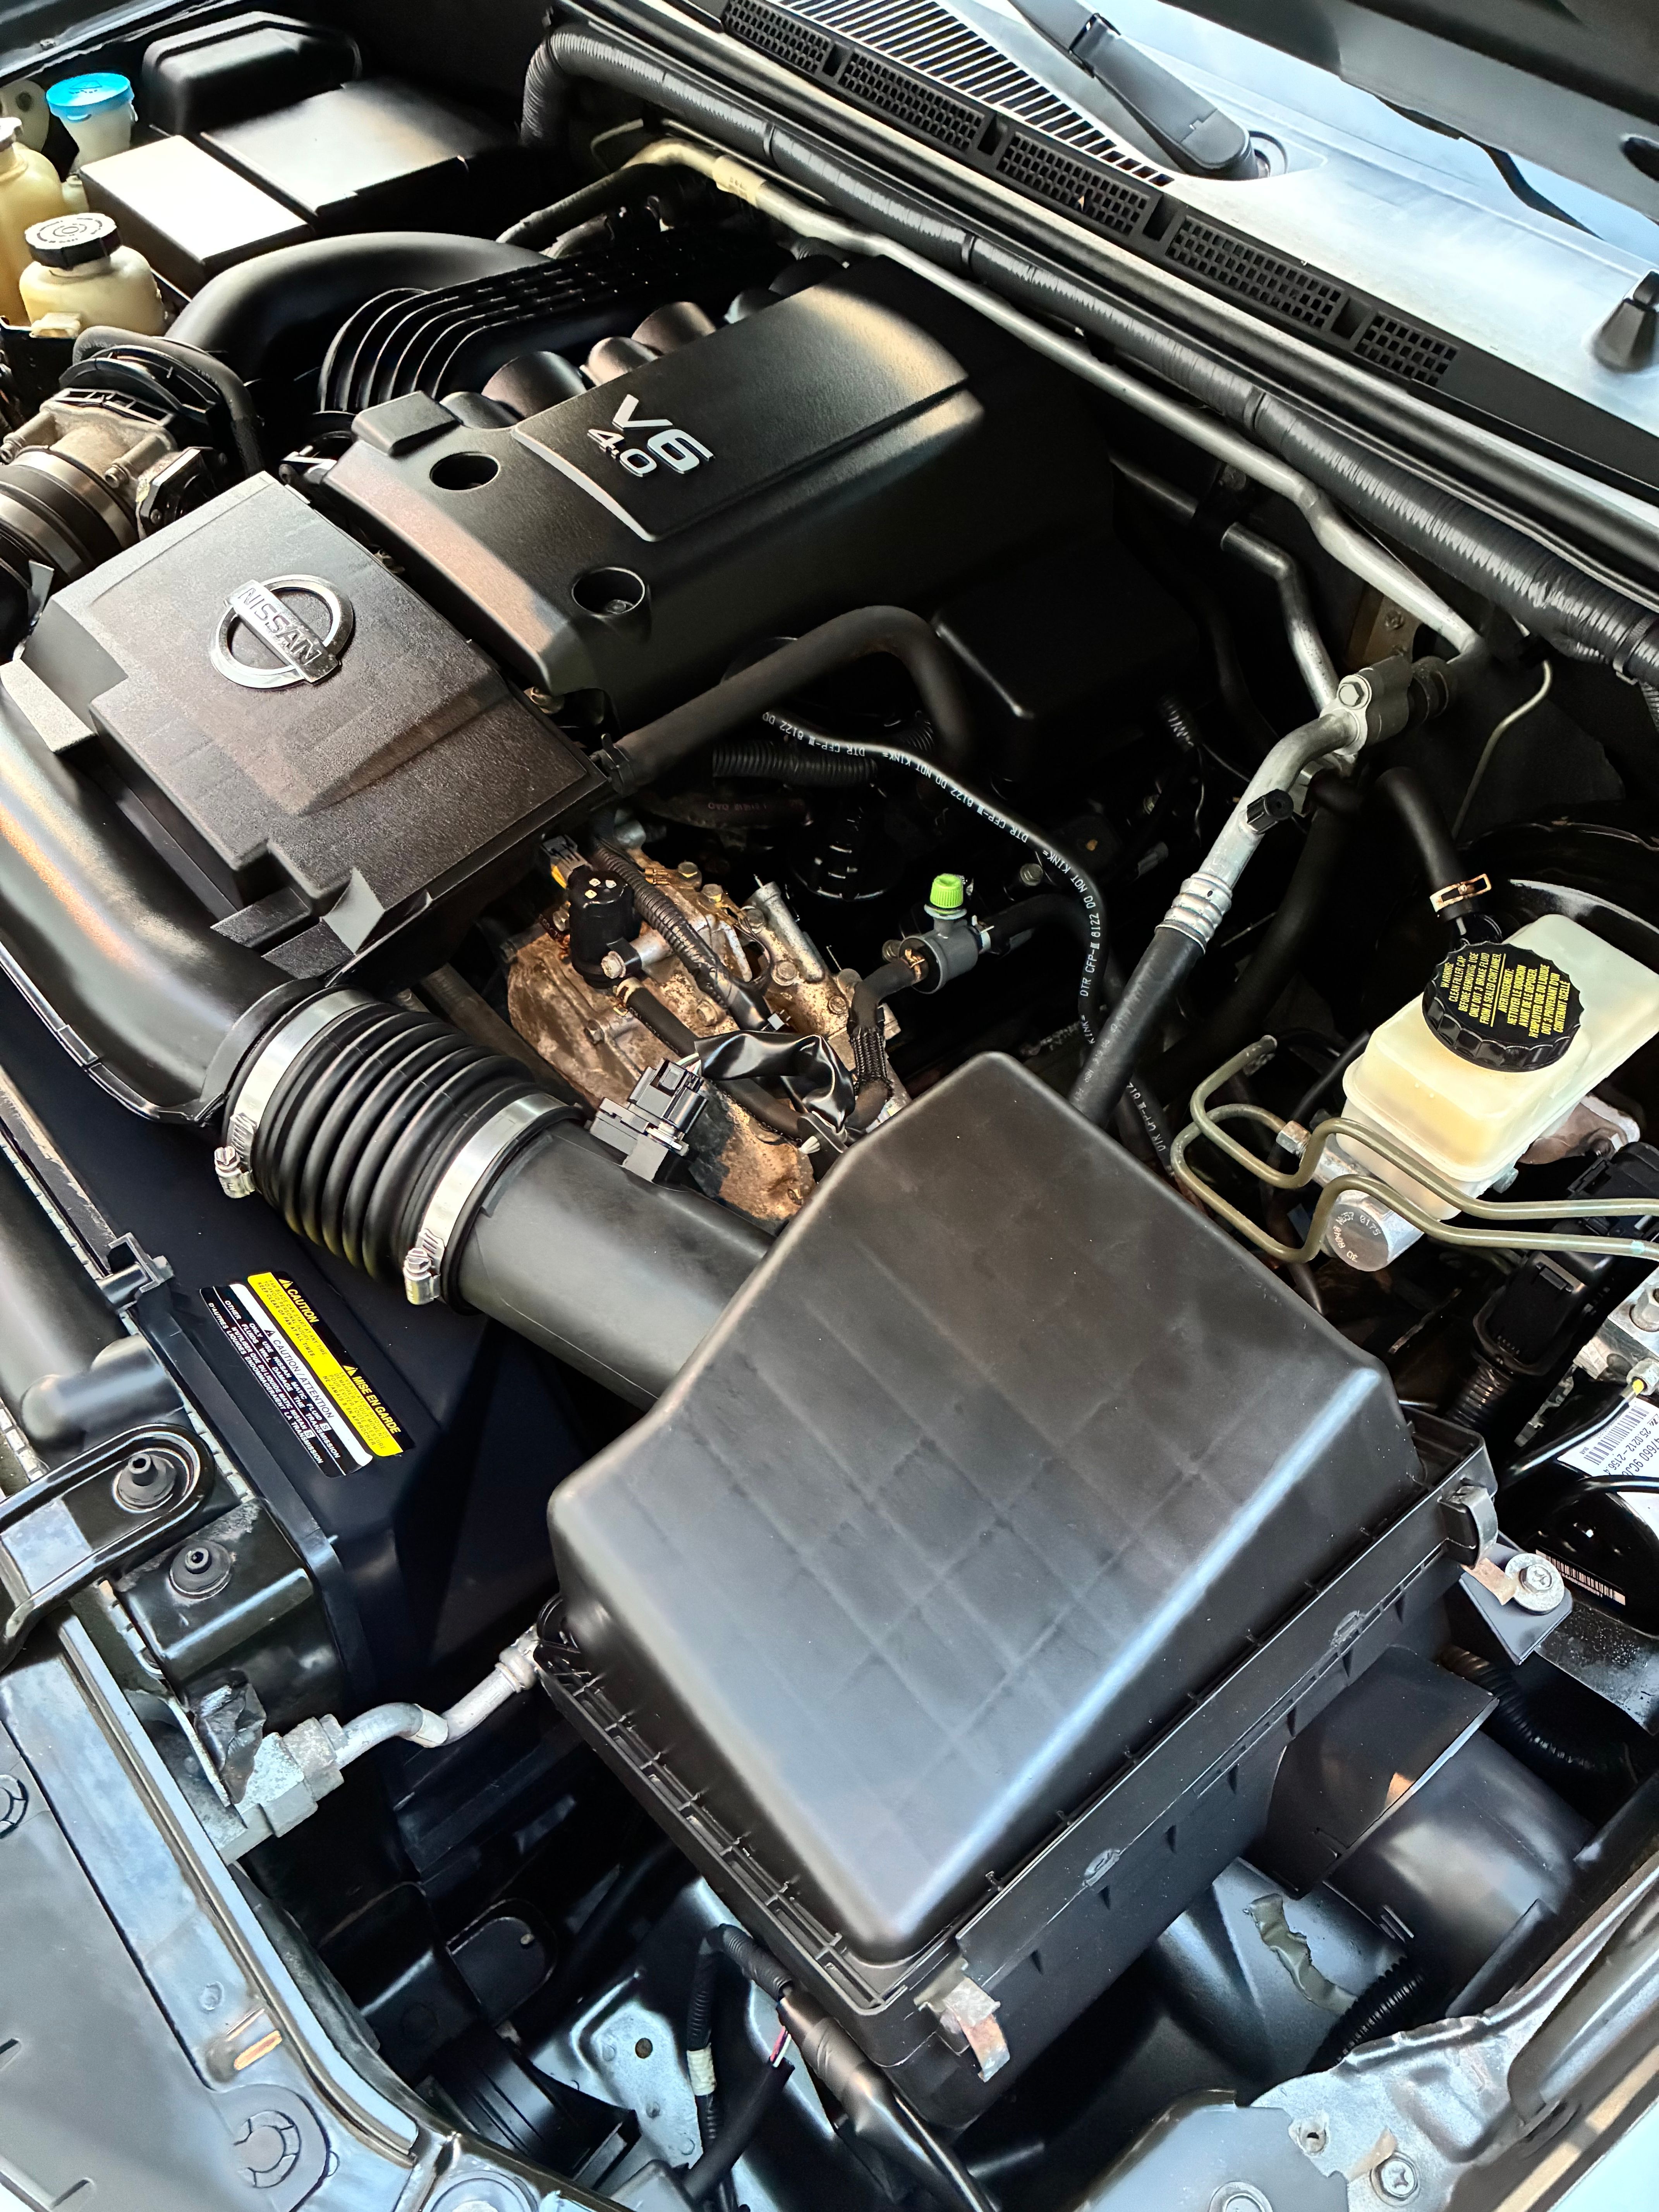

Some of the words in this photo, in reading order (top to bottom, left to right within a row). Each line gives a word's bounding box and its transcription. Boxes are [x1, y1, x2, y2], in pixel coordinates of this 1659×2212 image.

[612, 394, 715, 474] V6
[587, 429, 657, 477] 4.0
[237, 587, 322, 666] NISSAN
[780, 720, 804, 740] 8122
[847, 744, 865, 757] DTR
[915, 764, 932, 778] NOT
[936, 776, 948, 789] DO
[951, 787, 974, 807] 8122
[1010, 825, 1029, 843] DTR
[1070, 875, 1087, 893] NOT
[1083, 895, 1096, 908] DO
[1089, 913, 1101, 938] 8122
[1456, 956, 1466, 967] CAP
[1468, 952, 1479, 963] USE
[1479, 953, 1490, 968] FLUID
[1487, 953, 1501, 982] CONTAINER.
[1440, 961, 1454, 988] WARNING:
[1453, 967, 1464, 985] FILLER
[1463, 964, 1476, 991] REMOVING.
[1475, 968, 1487, 986] BRAKE
[1513, 965, 1527, 990] BOUCHON
[1523, 969, 1537, 993] DÉPOSER.
[1537, 964, 1549, 985] LIQUIDE
[1549, 973, 1560, 986] D'UN
[1080, 977, 1092, 996] DTR
[1448, 984, 1460, 1002] CLEAN
[1472, 991, 1482, 1003] DOT
[1483, 983, 1496, 1003] SEALED
[1498, 969, 1514, 1013] AVERTISSEMENT:
[1536, 984, 1546, 993] DU
[1556, 981, 1571, 1000] SCELLÉ
[1458, 991, 1471, 1012] BEFORE
[1522, 1000, 1532, 1008] DE
[1534, 993, 1545, 1004] QUE
[1544, 985, 1558, 1018] PROVENANT
[1469, 1003, 1480, 1017] ONLY
[1480, 1008, 1491, 1024] FROM
[1507, 997, 1520, 1025] NETTOYER
[1518, 1008, 1530, 1027] AVANT
[1553, 1000, 1567, 1032] CONTENANT
[1541, 1022, 1552, 1035] DOT
[257, 1282, 269, 1293] KEEP
[266, 1294, 280, 1309] CLEAR
[282, 1317, 292, 1325] FAN
[294, 1333, 304, 1341] ALL
[267, 1287, 280, 1300] AVOID
[278, 1302, 297, 1324] PERSONAL
[268, 1280, 277, 1288] FAN
[275, 1289, 288, 1303] BLADE
[285, 1304, 295, 1313] CAN
[293, 1314, 306, 1327] START
[308, 1334, 318, 1344] ANY
[287, 1289, 319, 1322] CAUTION
[225, 1300, 241, 1319] OTHER
[241, 1324, 259, 1343] FLUIDS
[259, 1348, 271, 1362] WILL
[272, 1367, 293, 1391] DAMAGE
[294, 1396, 305, 1408] THE
[306, 1413, 340, 1458] TRANSMISSION
[231, 1327, 253, 1352] N'UTILISER
[250, 1353, 261, 1364] QUE
[264, 1372, 282, 1393] LIQUIDE
[278, 1393, 293, 1408] MATIC
[290, 1410, 307, 1429] NISSAN
[249, 1323, 263, 1337] ONLY
[262, 1341, 273, 1353] USE
[273, 1357, 292, 1378] NISSAN
[291, 1382, 307, 1400] MATIC
[306, 1403, 322, 1420] FLUID
[273, 1340, 301, 1371] CAUTION
[299, 1378, 334, 1418] ATTENTION
[206, 1303, 228, 1329] D'AUTRES
[227, 1331, 247, 1355] LIQUIDES
[244, 1357, 286, 1409] ENDOMMAGERAIENT
[291, 1421, 323, 1463] TRANSMISSION
[328, 1374, 341, 1388] POUR
[338, 1388, 355, 1406] ÉVITER
[352, 1407, 367, 1423] TOUTE
[333, 1372, 356, 1399] DÉMARRER
[357, 1405, 369, 1418] TOUT
[367, 1418, 385, 1439] MOMENT
[344, 1379, 370, 1410] VENTILATEUR
[368, 1412, 384, 1431] RISQUE
[352, 1376, 372, 1394] MISE
[366, 1395, 381, 1406] EN
[375, 1407, 401, 1434] GARDE
[328, 1383, 345, 1401] JAMAIS
[351, 1415, 376, 1446] APPROCHER
